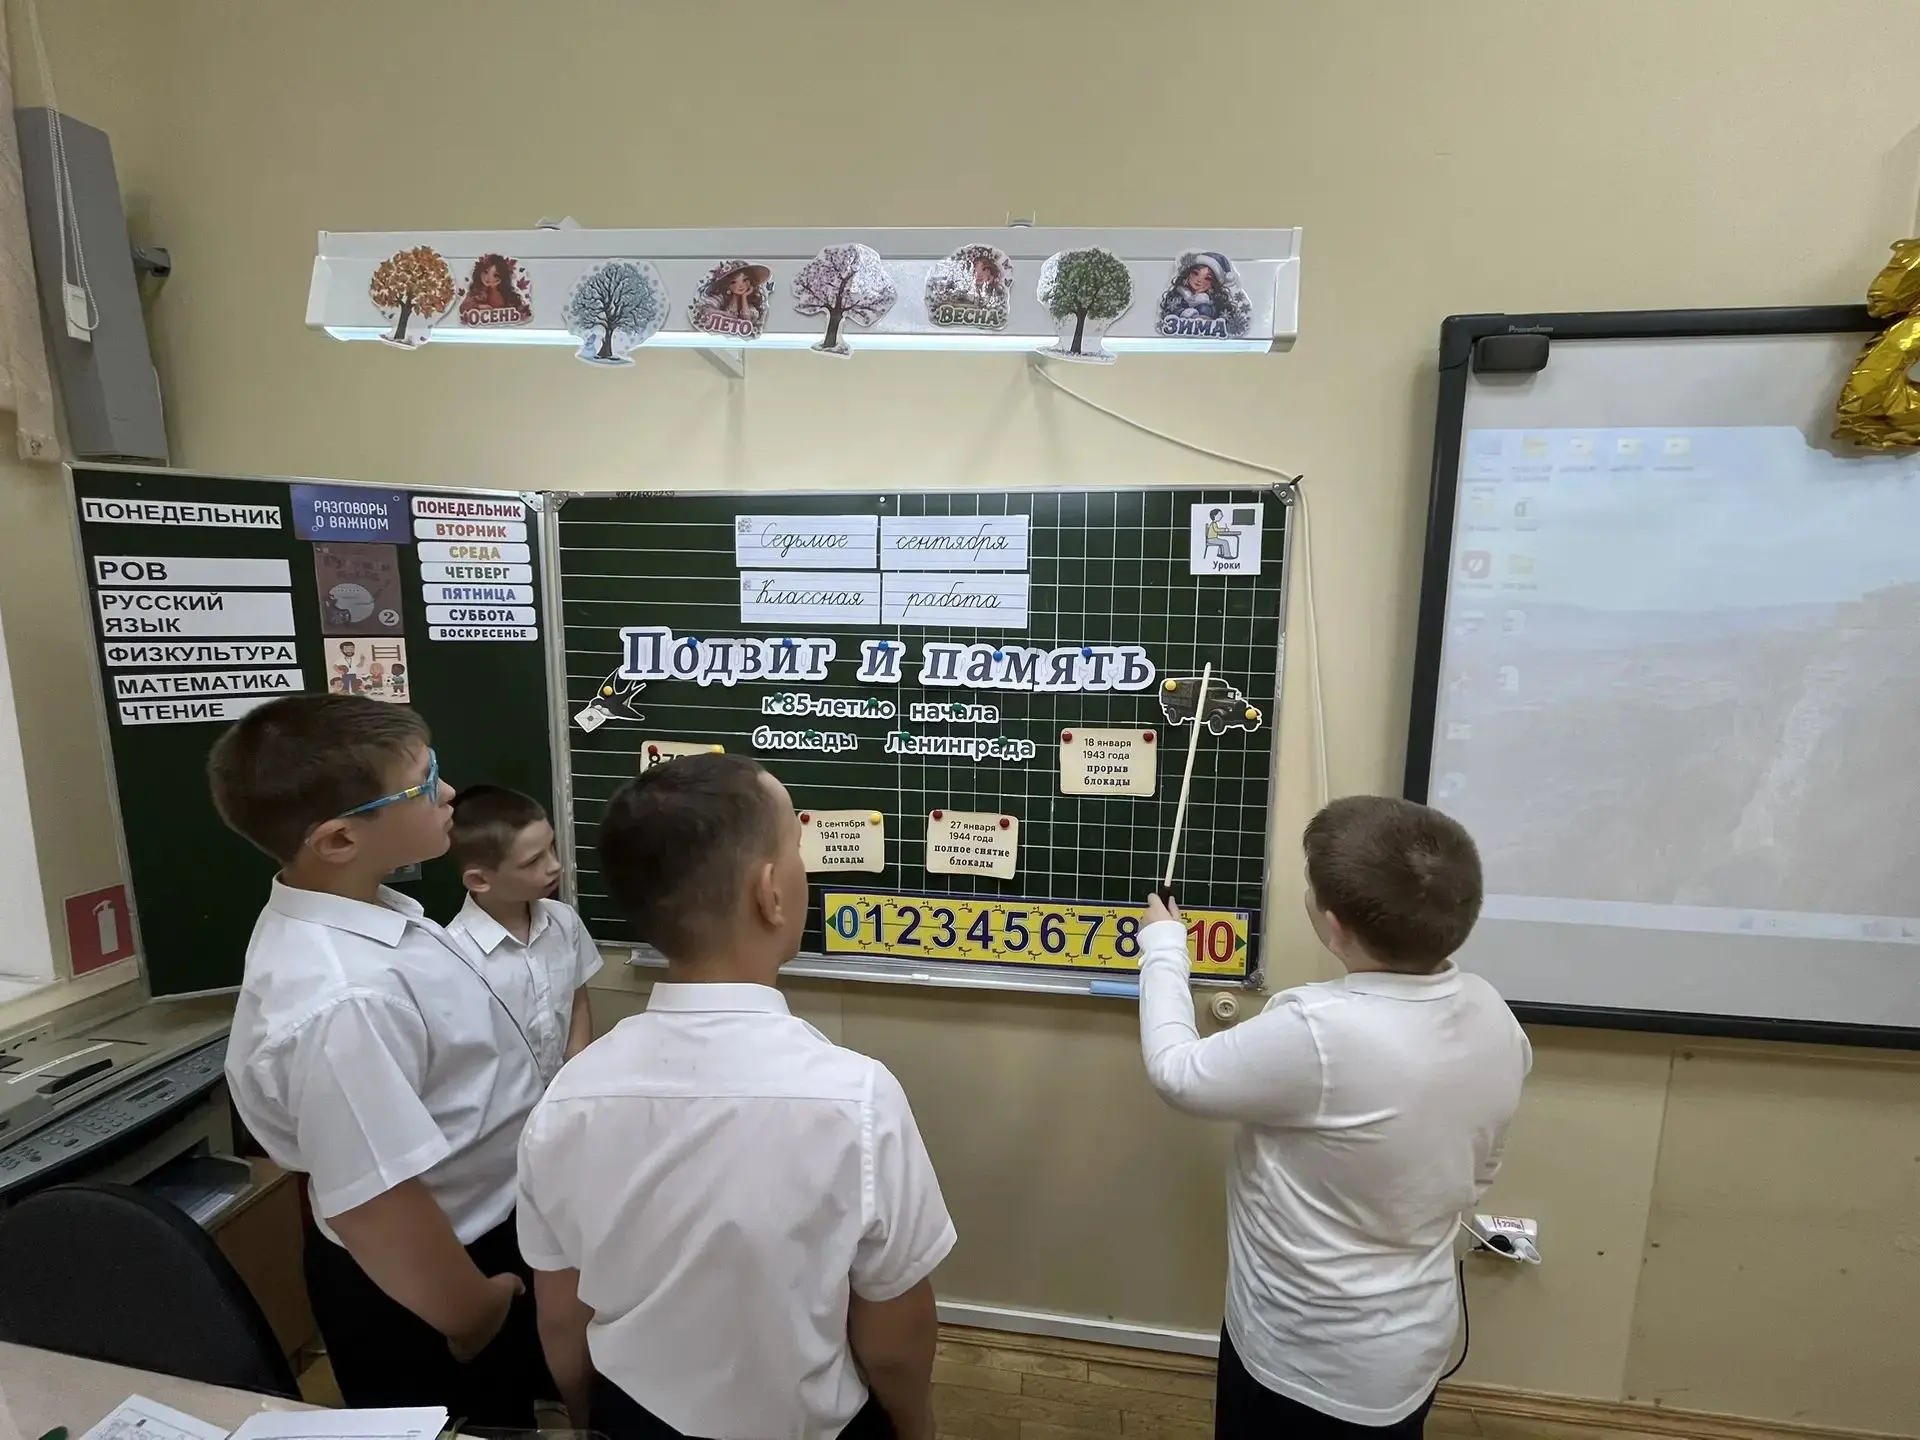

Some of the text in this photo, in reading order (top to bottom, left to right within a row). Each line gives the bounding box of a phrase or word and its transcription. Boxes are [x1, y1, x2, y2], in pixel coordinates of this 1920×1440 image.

[468, 308, 520, 325] ОСЕНЬ
[939, 305, 999, 326] ВЕСНА
[704, 314, 753, 336] ЛЕТО
[1163, 317, 1228, 338] ЗИМА
[85, 501, 280, 526] ПОНЕДЕЛЬНИК
[313, 500, 388, 516] РАЗГОВОРЫ
[416, 500, 522, 518] ПОНЕДЕЛЬНИК
[315, 515, 389, 531] О ВАЖНОМ
[435, 523, 507, 538] ВТОРНИК
[760, 522, 1009, 562] Седьмое сентября
[448, 545, 501, 561] СРЕДА
[98, 560, 168, 582] РОВ
[445, 566, 511, 580] ЧЕТВЕРГ
[1212, 560, 1241, 572] Уроки
[101, 592, 224, 611] РУССКИЙ
[441, 587, 516, 602] ПЯТНИЦА
[755, 578, 1002, 618] Классная работа
[383, 611, 395, 624] 2
[449, 609, 515, 622] СУББОТА
[105, 617, 181, 634] ЯЗЫК
[439, 628, 527, 639] ВОСКРЕСЕНЬЕ
[107, 645, 293, 663] ФИЗКУЛЬТУРА
[624, 631, 1150, 686] Подвиг и память
[117, 673, 290, 694] МАТЕМАТИКА
[122, 702, 225, 721] ЧТЕНИЕ
[763, 696, 998, 722] к 85-летию начала
[753, 726, 1034, 759] блокады Ленинграда
[1084, 738, 1132, 749] 18 января
[647, 753, 685, 768] 87
[1082, 750, 1130, 760] 1943 года
[1086, 765, 1129, 775] прорыв
[1084, 776, 1131, 786] блокады
[816, 819, 866, 831] 8 сентября
[950, 821, 997, 833] 27 января
[819, 831, 861, 841] 1941 года
[949, 831, 994, 844] 1944 года
[825, 843, 860, 852] начало
[933, 844, 1011, 858] полное снятие
[822, 855, 865, 866] блокады
[949, 856, 994, 869] блокады
[836, 903, 1236, 963] 0 1 2 3 4 5 6 7 8 10
